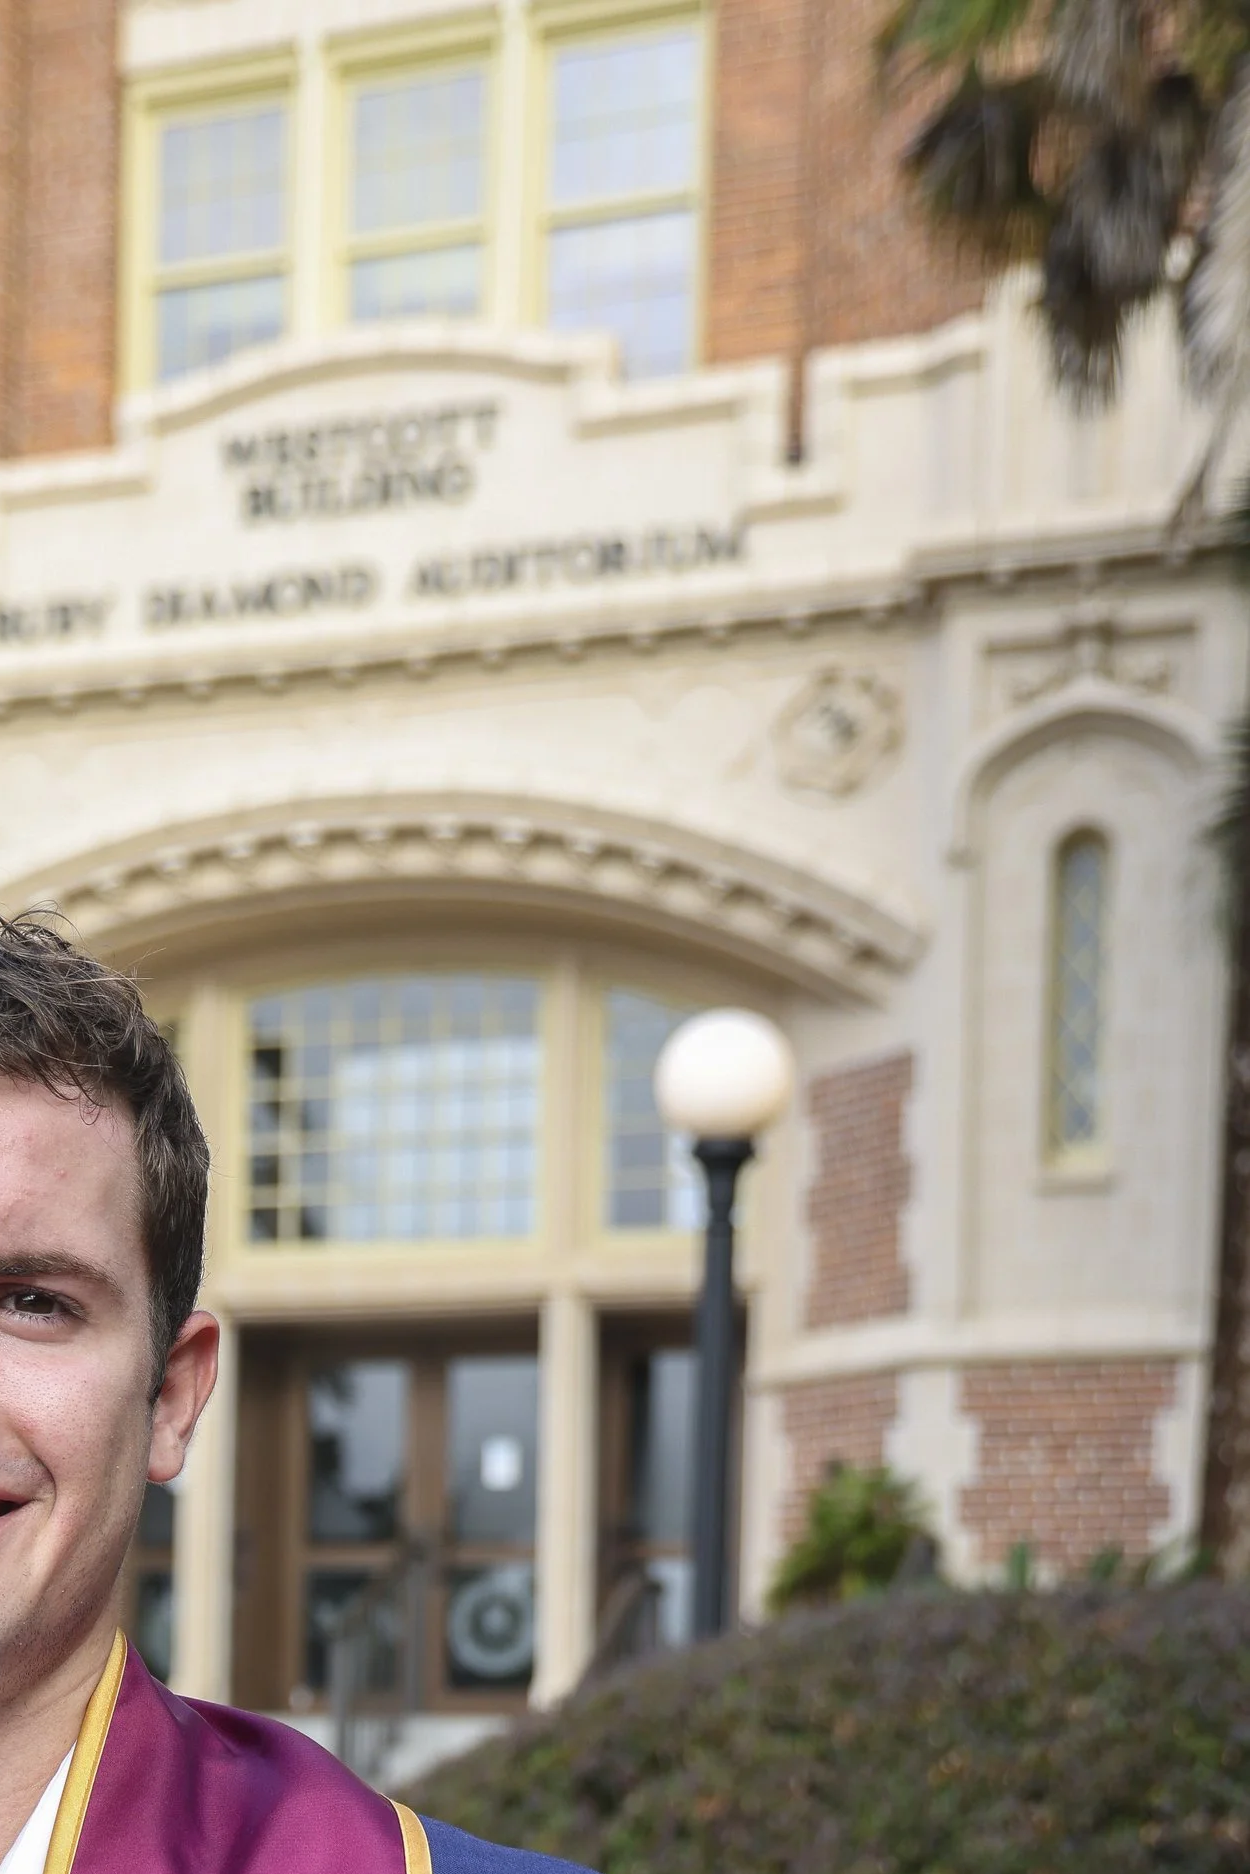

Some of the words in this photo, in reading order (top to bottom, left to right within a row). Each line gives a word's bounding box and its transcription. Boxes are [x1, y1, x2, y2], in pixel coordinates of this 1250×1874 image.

[241, 455, 473, 521] BUILDING
[144, 561, 380, 630] DIAMOND
[407, 525, 746, 599] AUDITORIUM
